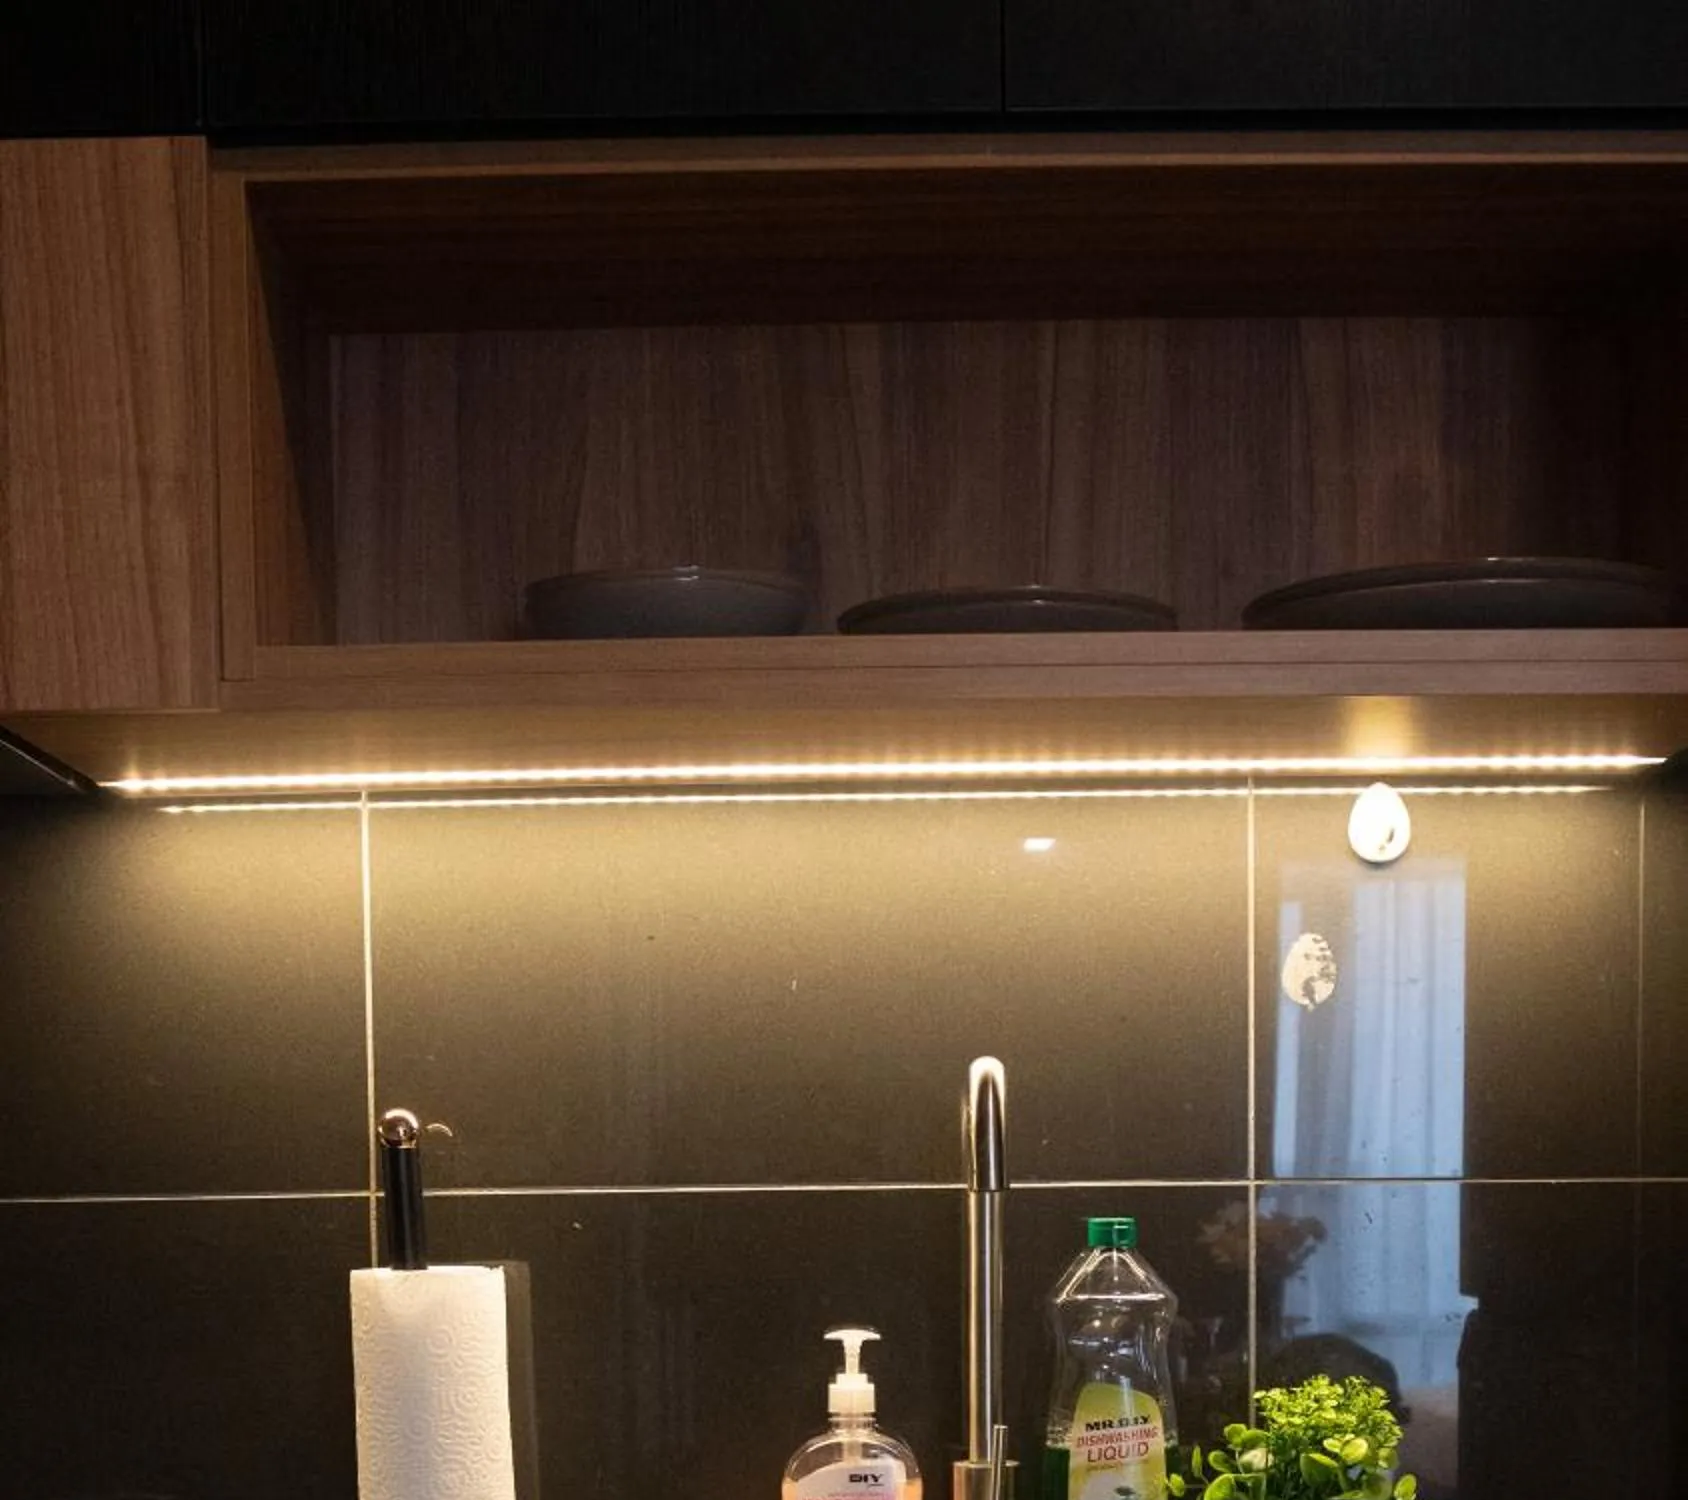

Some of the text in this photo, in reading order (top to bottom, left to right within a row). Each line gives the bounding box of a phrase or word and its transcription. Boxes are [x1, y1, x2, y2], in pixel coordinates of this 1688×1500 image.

[1076, 1426, 1158, 1447] DISHWASHING
[1087, 1441, 1149, 1462] LIQUID
[848, 1473, 884, 1483] DIY
